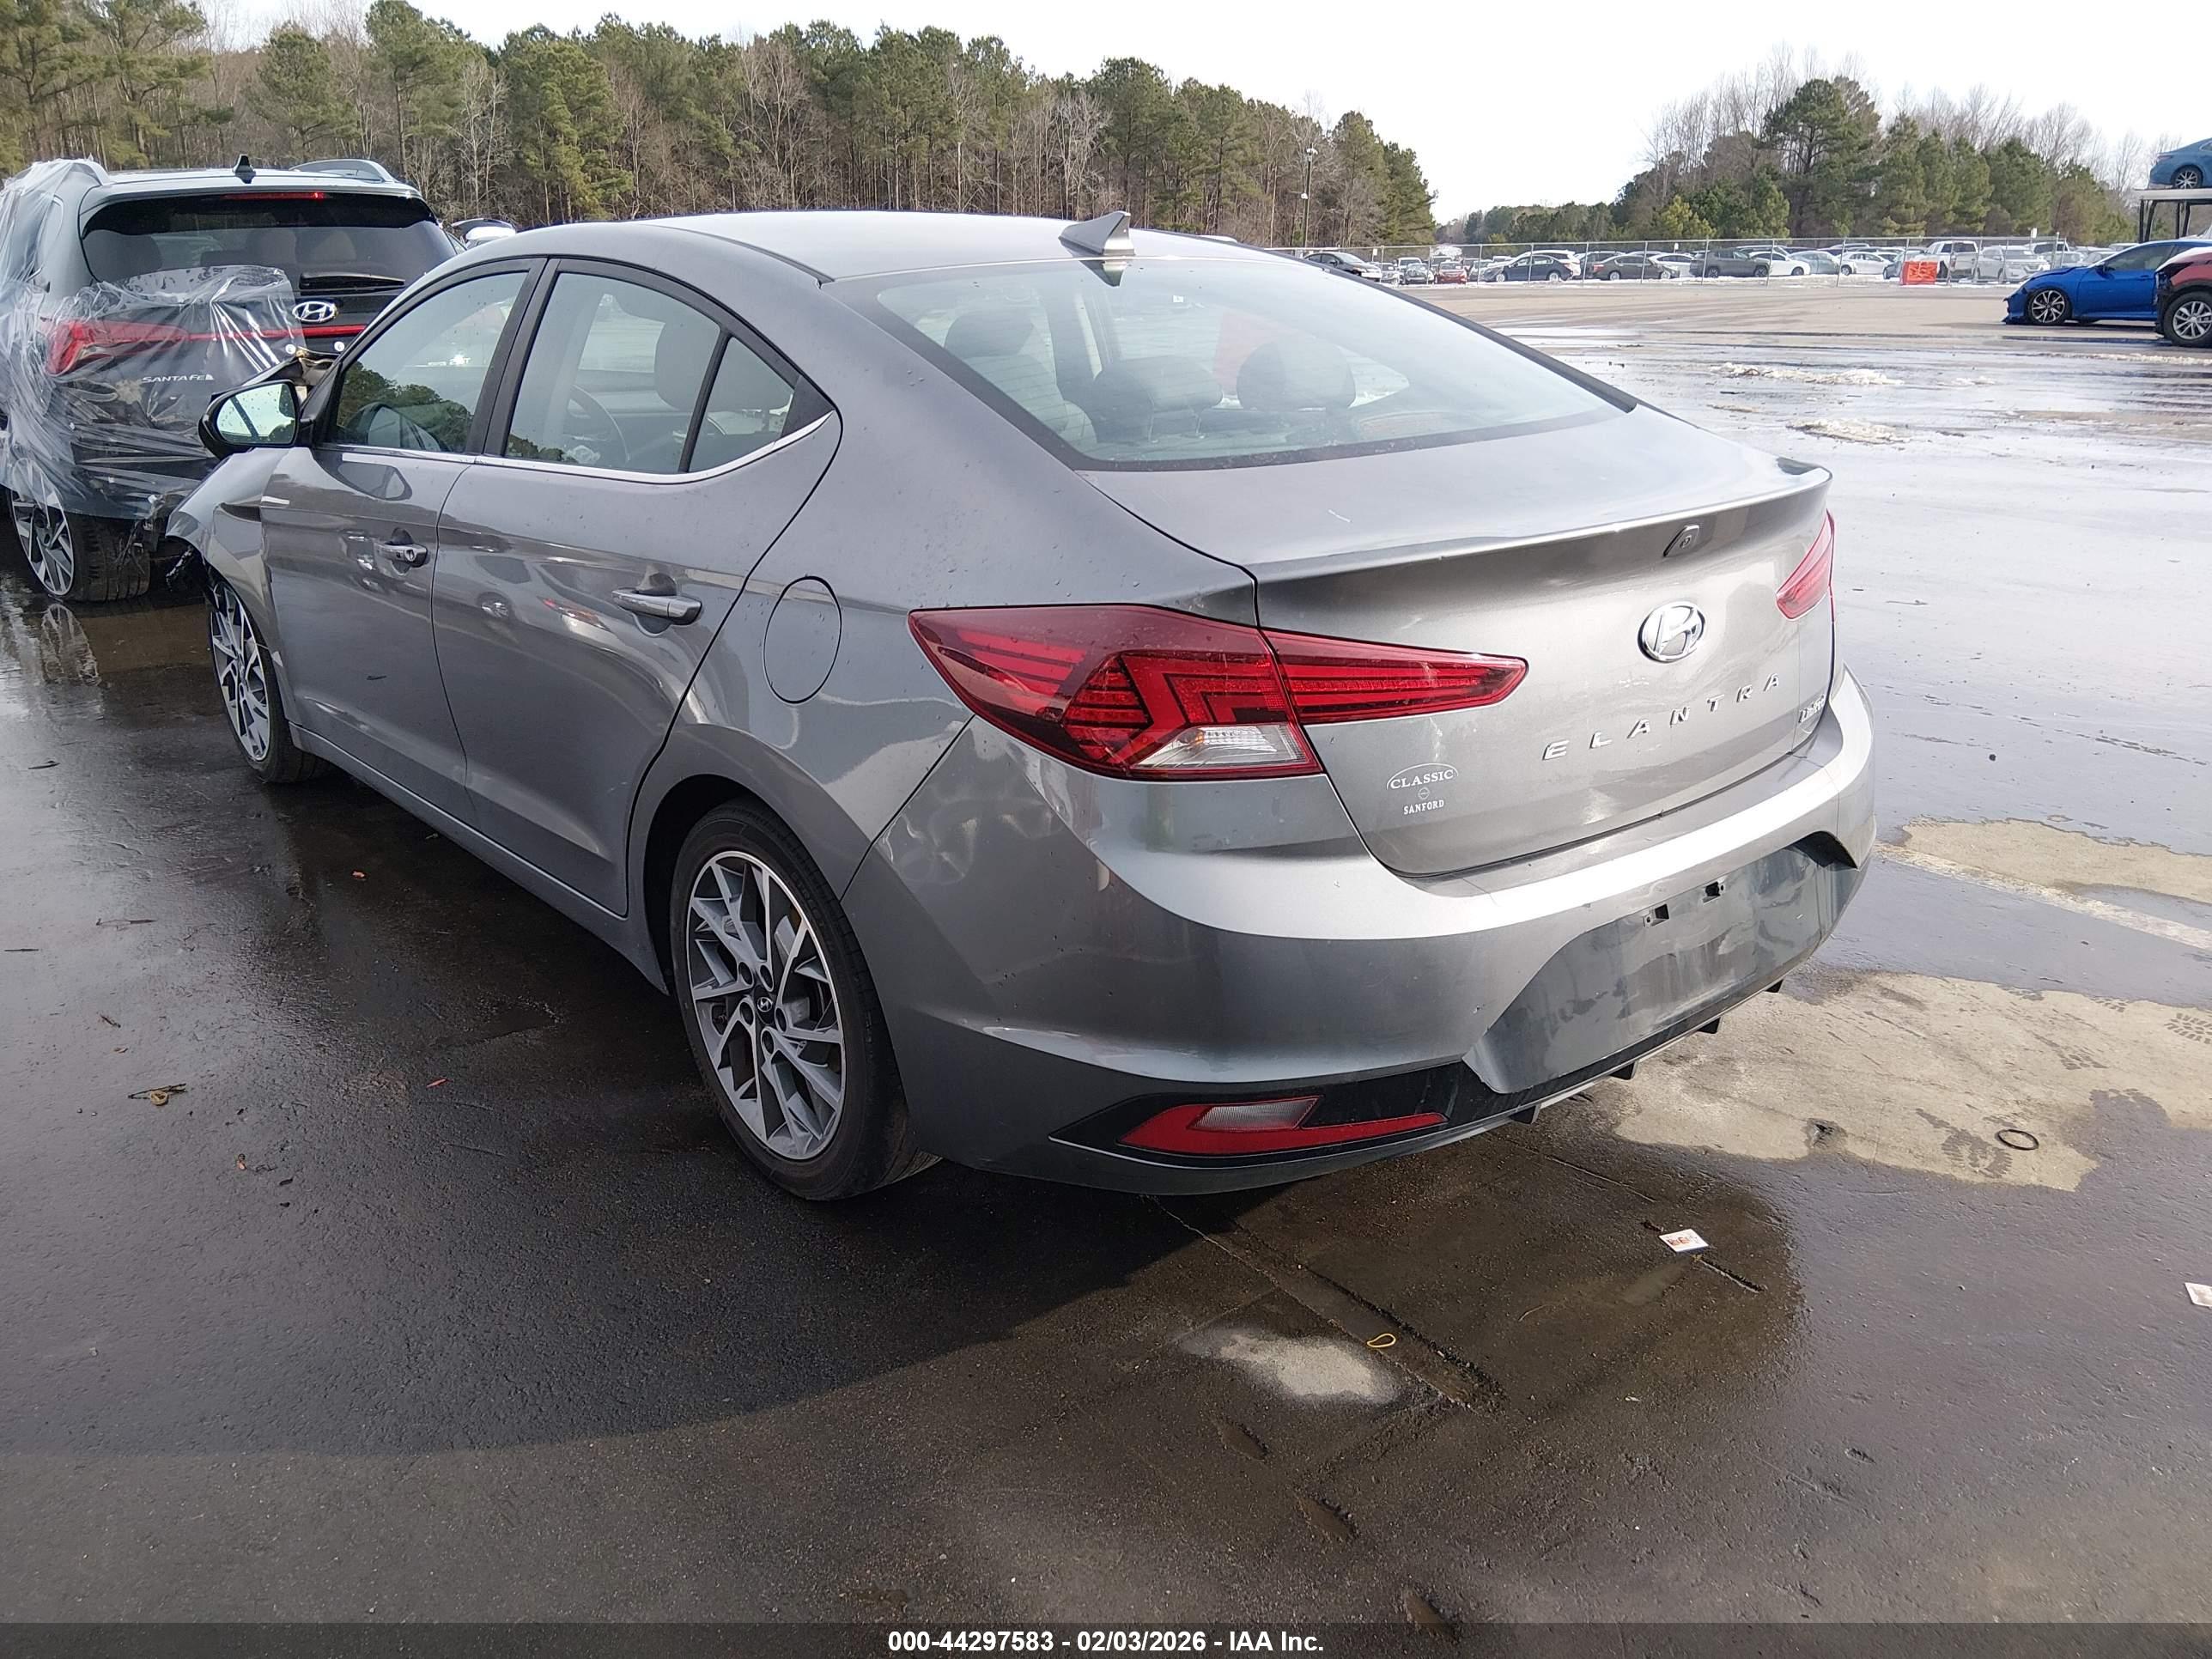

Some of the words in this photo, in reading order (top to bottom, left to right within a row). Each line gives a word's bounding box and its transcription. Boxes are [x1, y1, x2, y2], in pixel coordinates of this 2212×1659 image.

[1542, 672, 1780, 761] ELANTRA
[1390, 769, 1454, 789] CLASSIC
[1403, 799, 1444, 815] SANFORD
